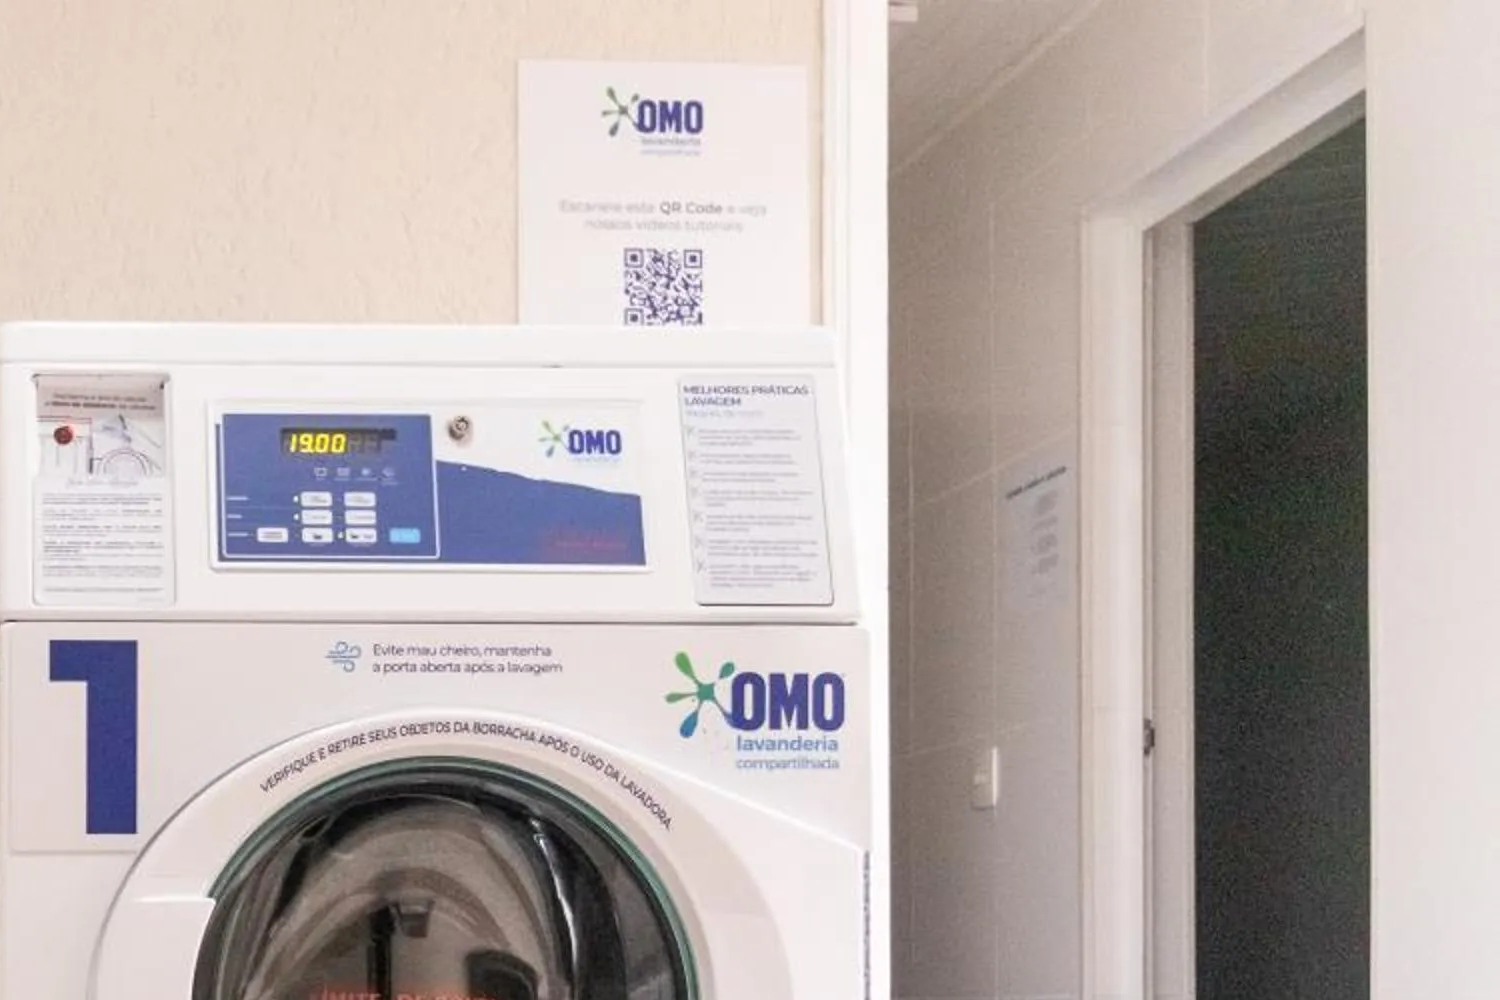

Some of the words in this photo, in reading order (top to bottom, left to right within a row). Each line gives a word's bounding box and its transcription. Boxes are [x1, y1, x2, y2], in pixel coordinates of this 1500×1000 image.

[637, 99, 704, 134] OMO
[660, 201, 681, 215] QR
[686, 201, 723, 214] Code
[683, 385, 749, 394] MELHORES
[684, 397, 742, 406] LAVAGEM
[568, 430, 622, 455] OMO
[373, 643, 404, 656] Evite
[407, 647, 437, 656] mau
[440, 643, 481, 658] cheiro,
[484, 643, 551, 657] mantenha
[383, 662, 417, 675] porta
[420, 661, 461, 673] aberta
[507, 661, 563, 675] lavagem
[731, 671, 845, 731] OMO
[49, 640, 138, 834] 1
[736, 735, 839, 751] lavanderia
[259, 754, 318, 794] VERIFIQUE
[318, 748, 327, 760] E
[328, 733, 367, 754] RETIRE
[368, 726, 397, 743] SEUS
[399, 721, 451, 737] OBJETOS
[453, 721, 470, 733] DA
[473, 721, 536, 742] BORRACHA
[569, 745, 581, 758] O
[581, 751, 603, 771] USO
[603, 763, 621, 783] DA
[735, 756, 840, 771] compartilhada
